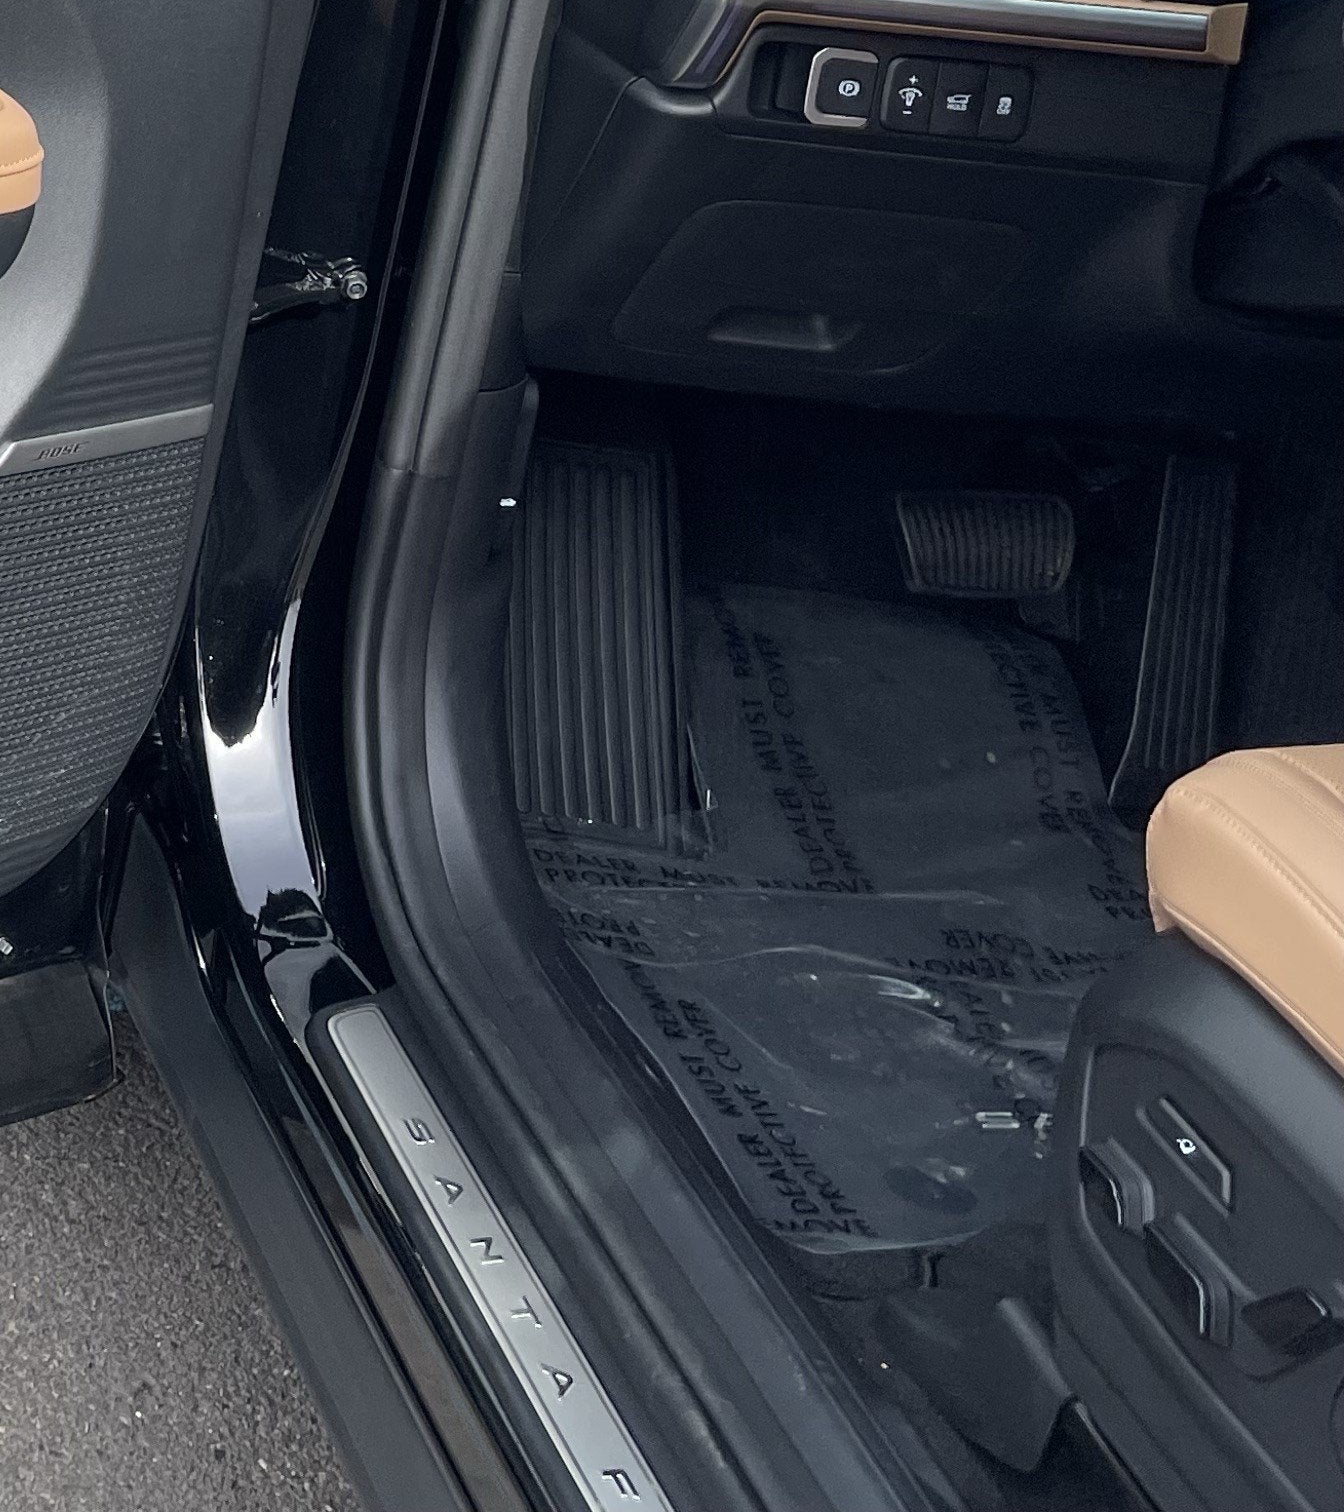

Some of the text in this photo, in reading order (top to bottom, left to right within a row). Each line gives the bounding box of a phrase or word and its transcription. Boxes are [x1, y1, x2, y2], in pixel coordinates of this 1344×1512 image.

[34, 441, 90, 461] BOSE
[533, 847, 640, 873] DEALER
[677, 998, 742, 1072] COVER
[678, 1051, 743, 1118] MUST
[736, 1133, 821, 1215] DEALER
[402, 1117, 575, 1402] SANTA
